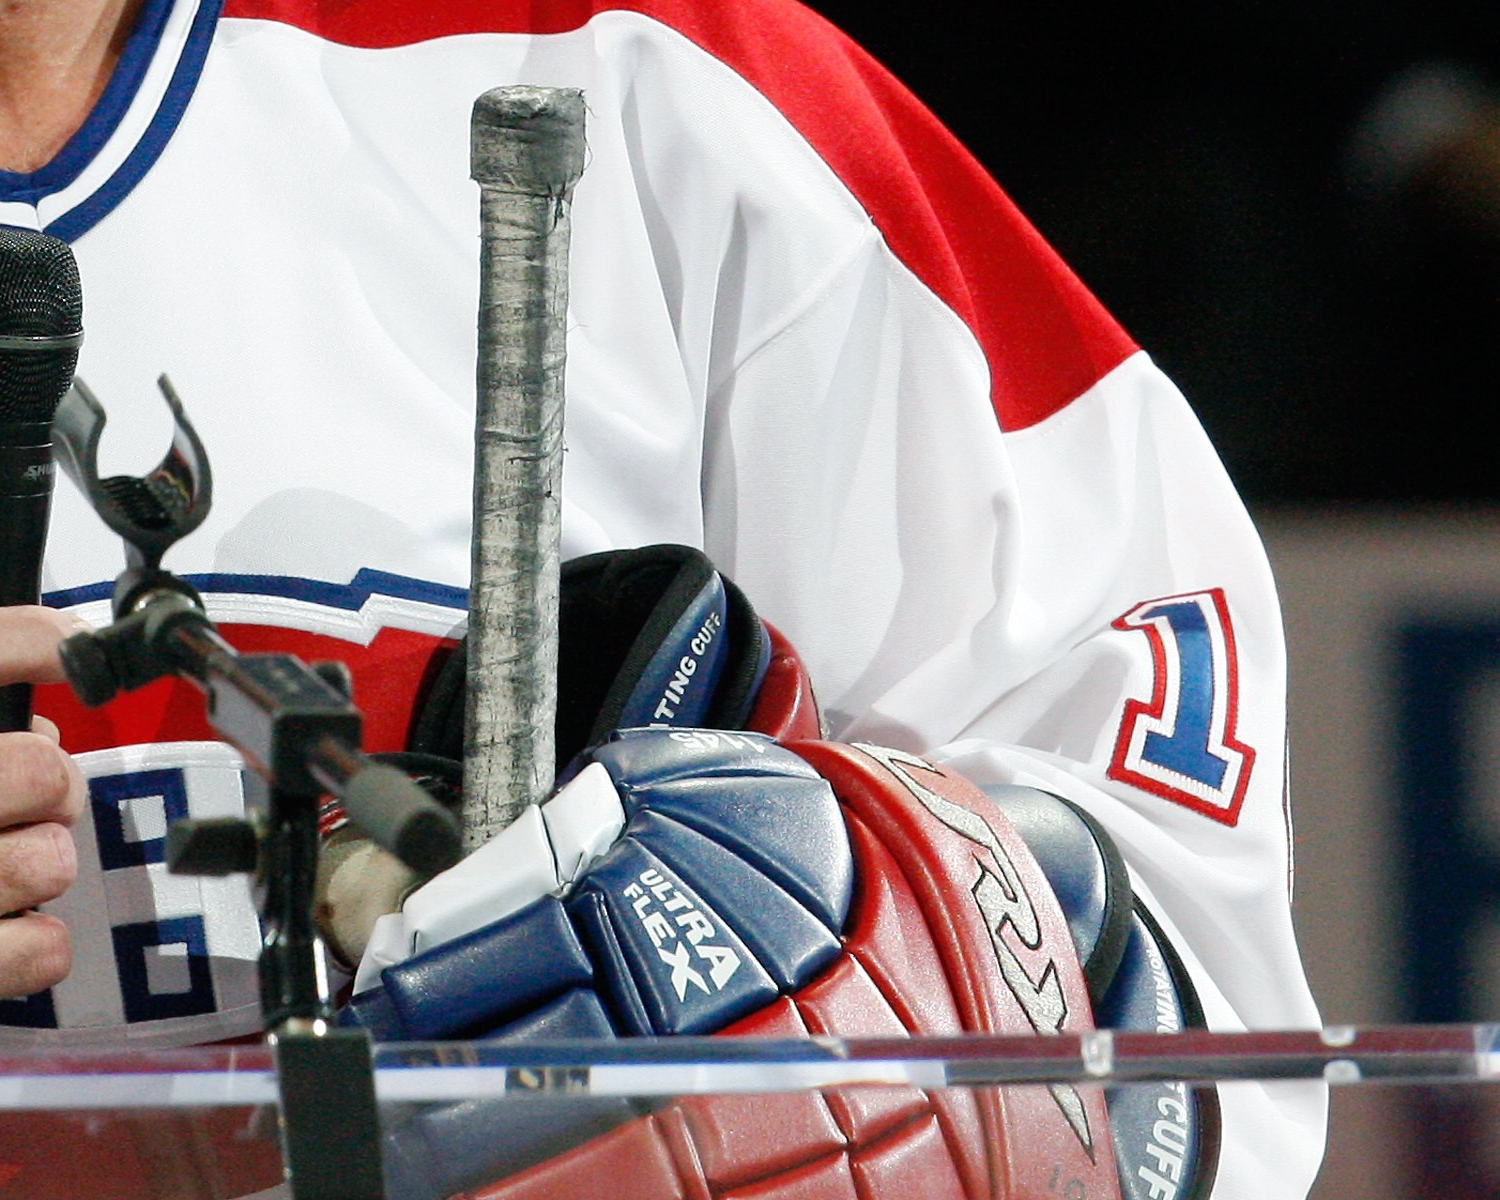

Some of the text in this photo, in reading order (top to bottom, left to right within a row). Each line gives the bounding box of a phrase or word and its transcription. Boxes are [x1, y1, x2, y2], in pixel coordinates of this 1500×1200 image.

[649, 611, 721, 729] TING CUFF
[623, 882, 712, 1003] FLEX
[639, 868, 741, 991] ULTRA
[1138, 1097, 1187, 1200] CUFF
